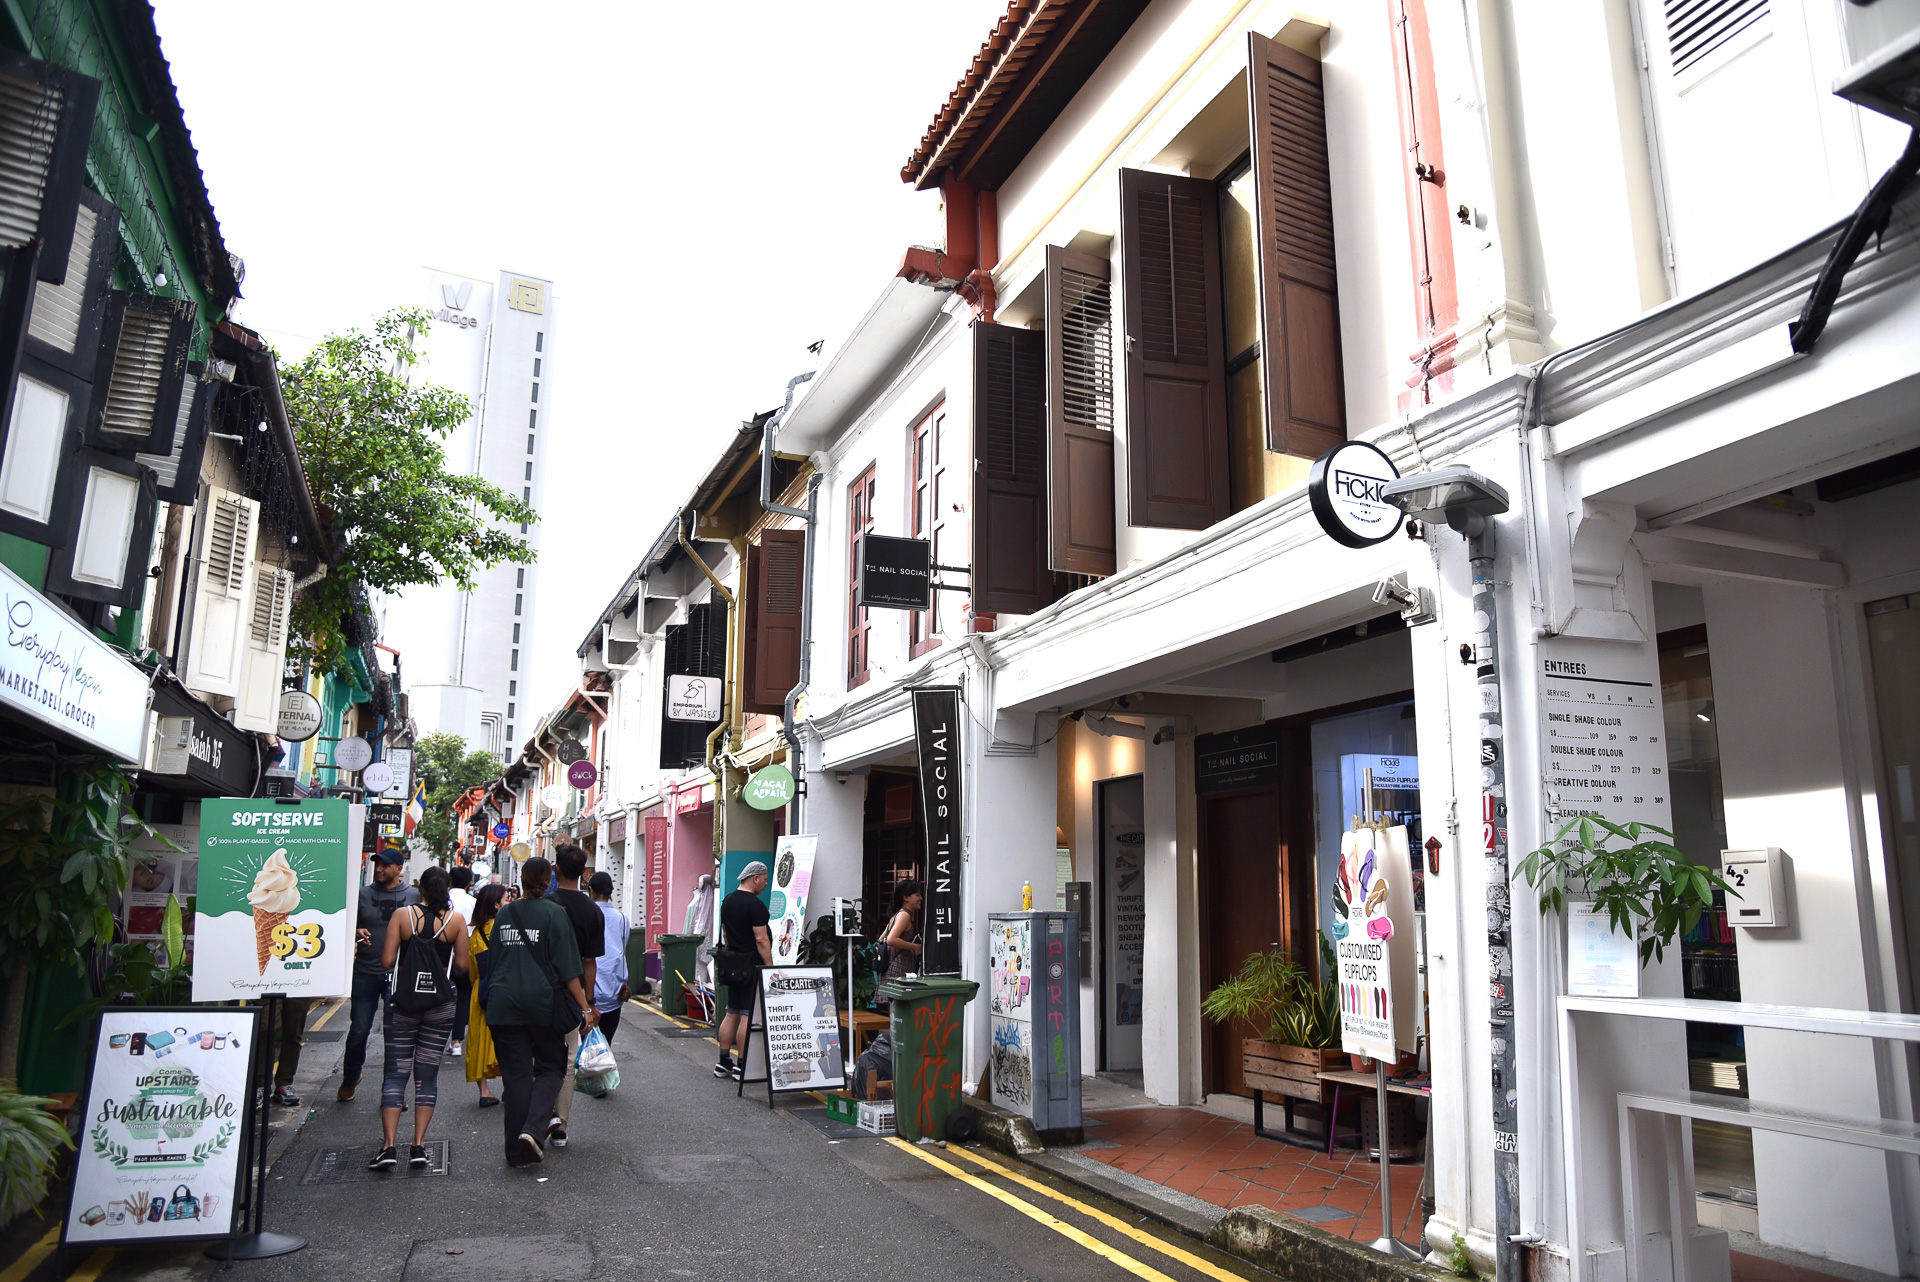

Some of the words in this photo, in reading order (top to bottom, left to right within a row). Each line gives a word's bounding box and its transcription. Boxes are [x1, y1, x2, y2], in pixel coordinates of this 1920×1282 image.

[431, 309, 477, 328] village
[879, 566, 896, 574] NAIL
[900, 568, 927, 577] SOCIAL
[1544, 660, 1587, 675] ENTREES
[1547, 689, 1571, 698] SERVICES
[1587, 692, 1595, 700] VS
[279, 711, 317, 722] TERNAL
[672, 708, 681, 717] BY
[685, 709, 717, 720] WASSIES
[1549, 713, 1570, 723] SINGLE
[1575, 715, 1594, 725] SHADE
[1597, 717, 1621, 727] COLOUR
[1551, 745, 1574, 755] DOUBLE
[1576, 746, 1596, 756] SHADE
[1598, 748, 1624, 758] COLOUR
[1220, 756, 1236, 767] NAIL
[1240, 751, 1268, 764] SOCIAL
[932, 722, 948, 818] SOCIAL
[1611, 765, 1621, 773] 229
[1632, 766, 1641, 774] 279
[1652, 767, 1661, 775] 329
[366, 774, 390, 782] elda
[1590, 779, 1617, 788] COLOUR
[231, 812, 324, 826] SOFTSERVE
[1559, 809, 1578, 818] LEACH
[1120, 834, 1131, 843] THE
[1131, 834, 1144, 844] CAR
[651, 840, 667, 886] Dunya
[936, 833, 951, 893] NAIL
[1726, 865, 1745, 887] 42
[1117, 895, 1142, 903] THRIFT
[651, 888, 663, 926] Deen
[269, 921, 326, 962] $3
[1340, 942, 1382, 960] CUSTOMISED
[284, 961, 312, 970] ONLY
[1345, 963, 1377, 981] FLIPFLOPS
[775, 980, 789, 989] THE
[767, 1005, 794, 1013] THRIFT
[769, 1024, 803, 1032] REWORK
[770, 1033, 812, 1041] BOOTLEGS
[771, 1042, 812, 1051] SNEAKERS
[772, 1051, 826, 1061] ACCESSORIES
[136, 1075, 200, 1087] UPSTAIRS
[97, 1094, 236, 1123] Sustainable
[1494, 1131, 1518, 1142] THAT
[1495, 1141, 1517, 1151] GUY
